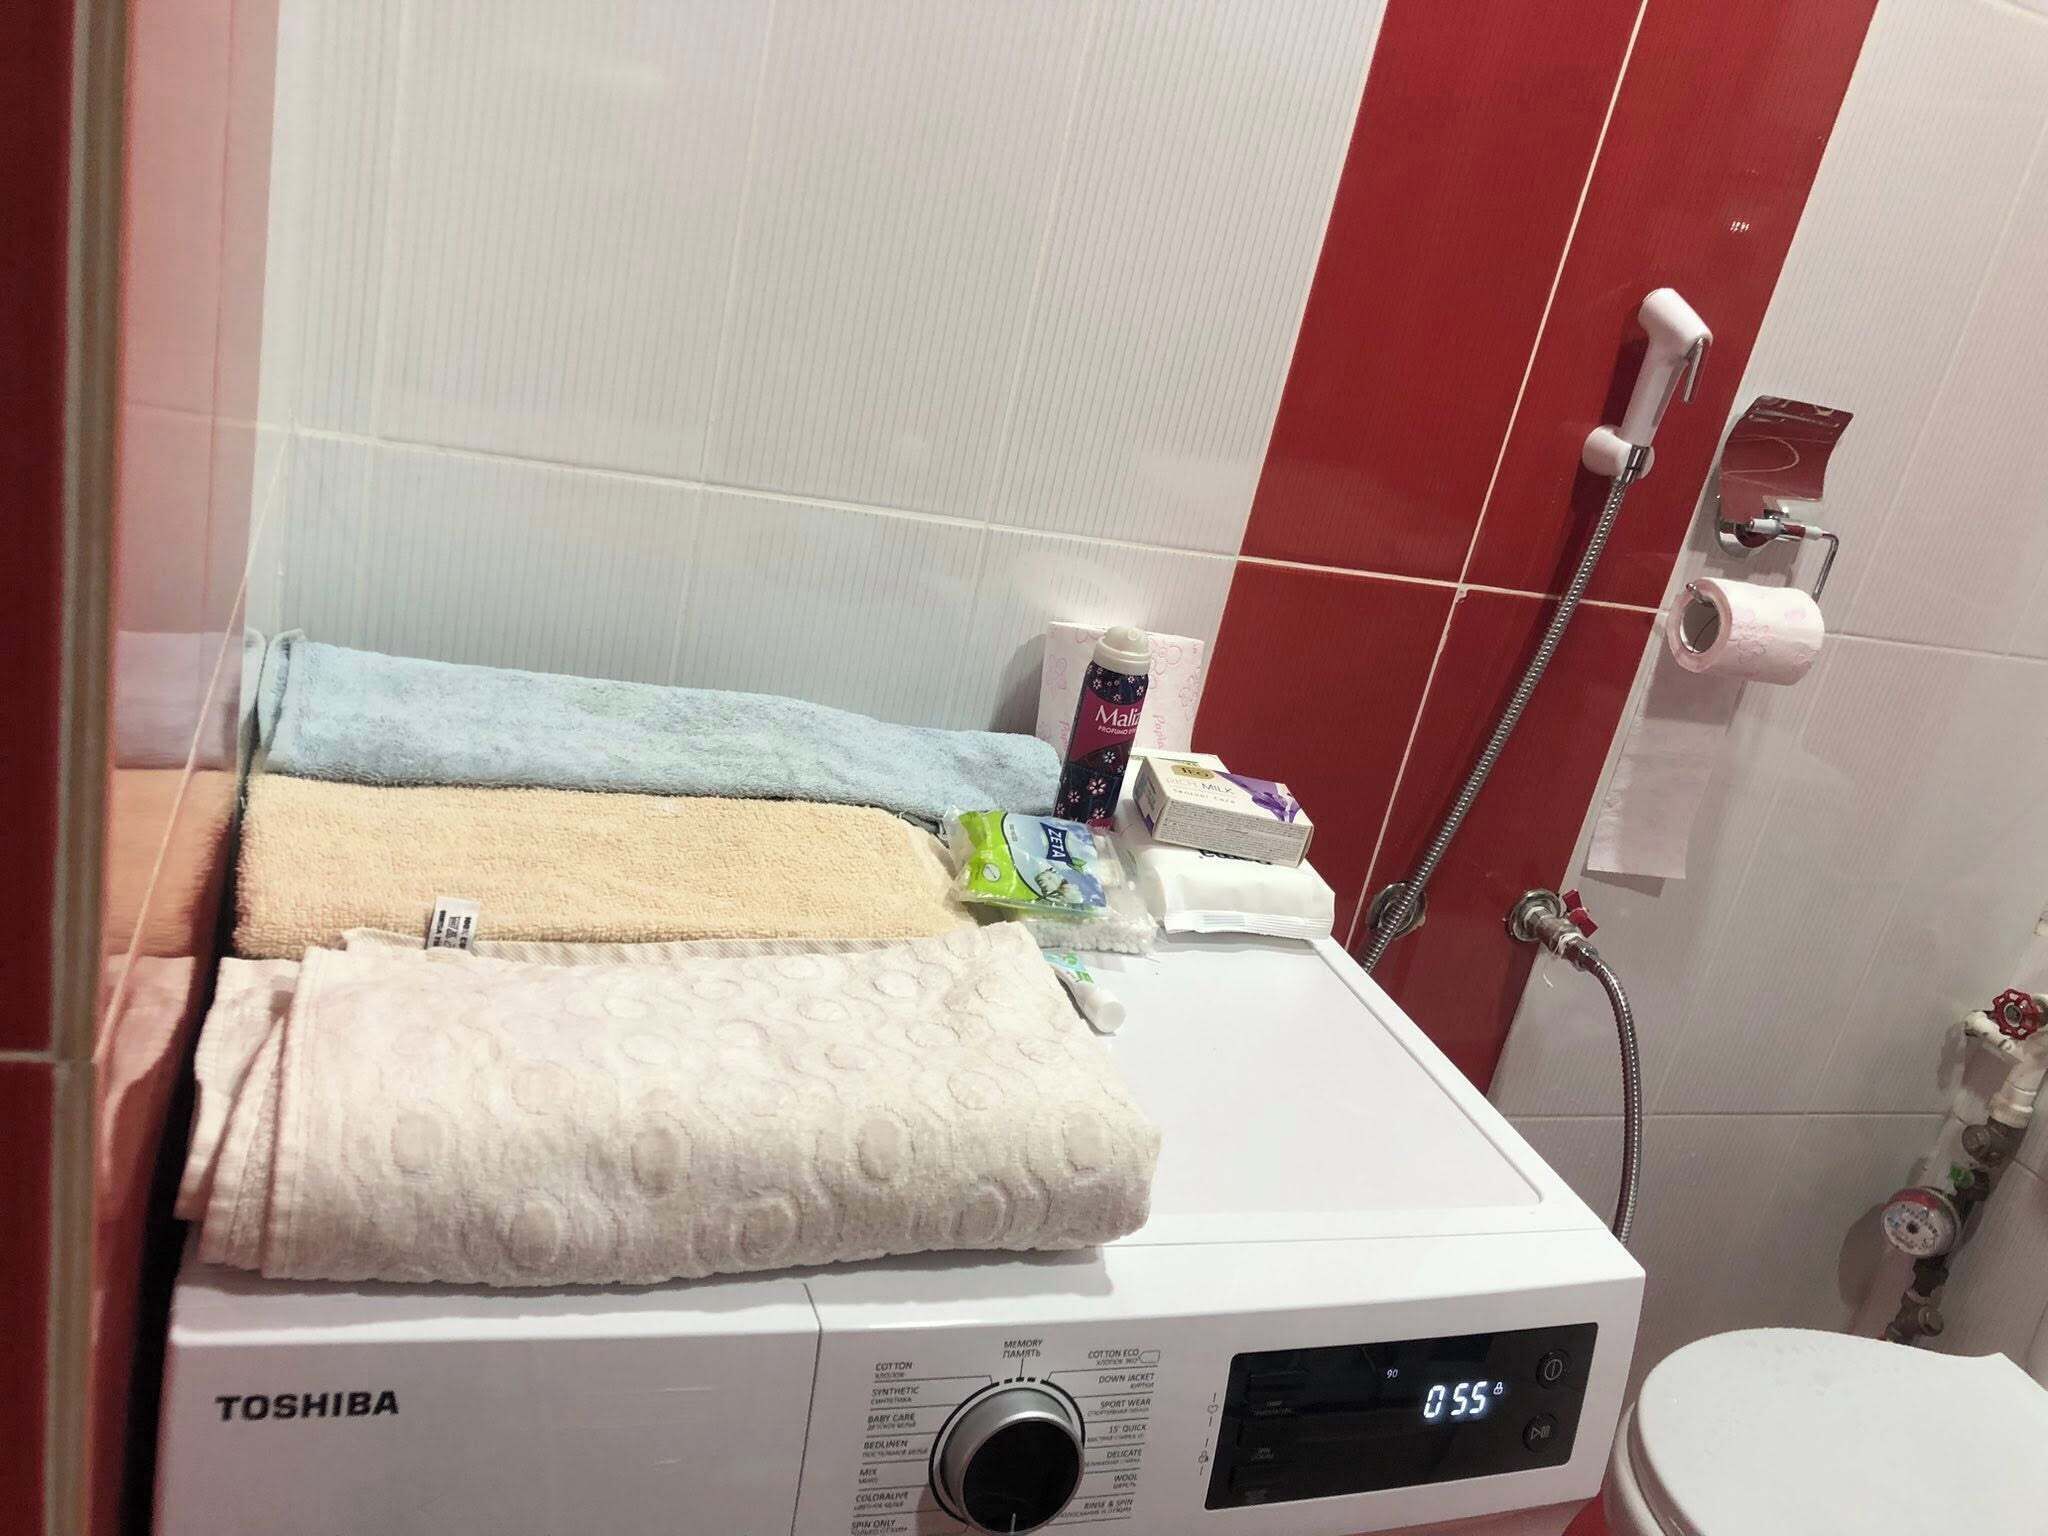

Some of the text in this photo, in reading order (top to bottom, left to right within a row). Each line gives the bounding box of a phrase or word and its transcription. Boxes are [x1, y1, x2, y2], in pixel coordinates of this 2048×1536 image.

[1095, 704, 1142, 727] Maliz
[1047, 828, 1066, 858] ZETA
[1003, 1339, 1043, 1348] MEMORY
[1087, 1348, 1140, 1359] COTTON ECO
[875, 1361, 913, 1371] COTTON
[1098, 1372, 1155, 1384] DOWN JACKET
[1386, 1369, 1398, 1378] 90
[872, 1386, 920, 1396] SYNTHETIC
[214, 1390, 399, 1421] TOSHIBA
[1100, 1398, 1151, 1408] SPORT WEAR
[867, 1412, 915, 1424] BABY CARE
[1122, 1423, 1147, 1433] QUICK
[863, 1440, 908, 1449] BEDLINEN
[1106, 1448, 1142, 1458] DELICATE
[859, 1468, 878, 1476] MIX
[1114, 1473, 1137, 1482] WOOL
[1083, 1500, 1105, 1510] RINSE
[851, 1519, 896, 1529] SPIN ONLY
